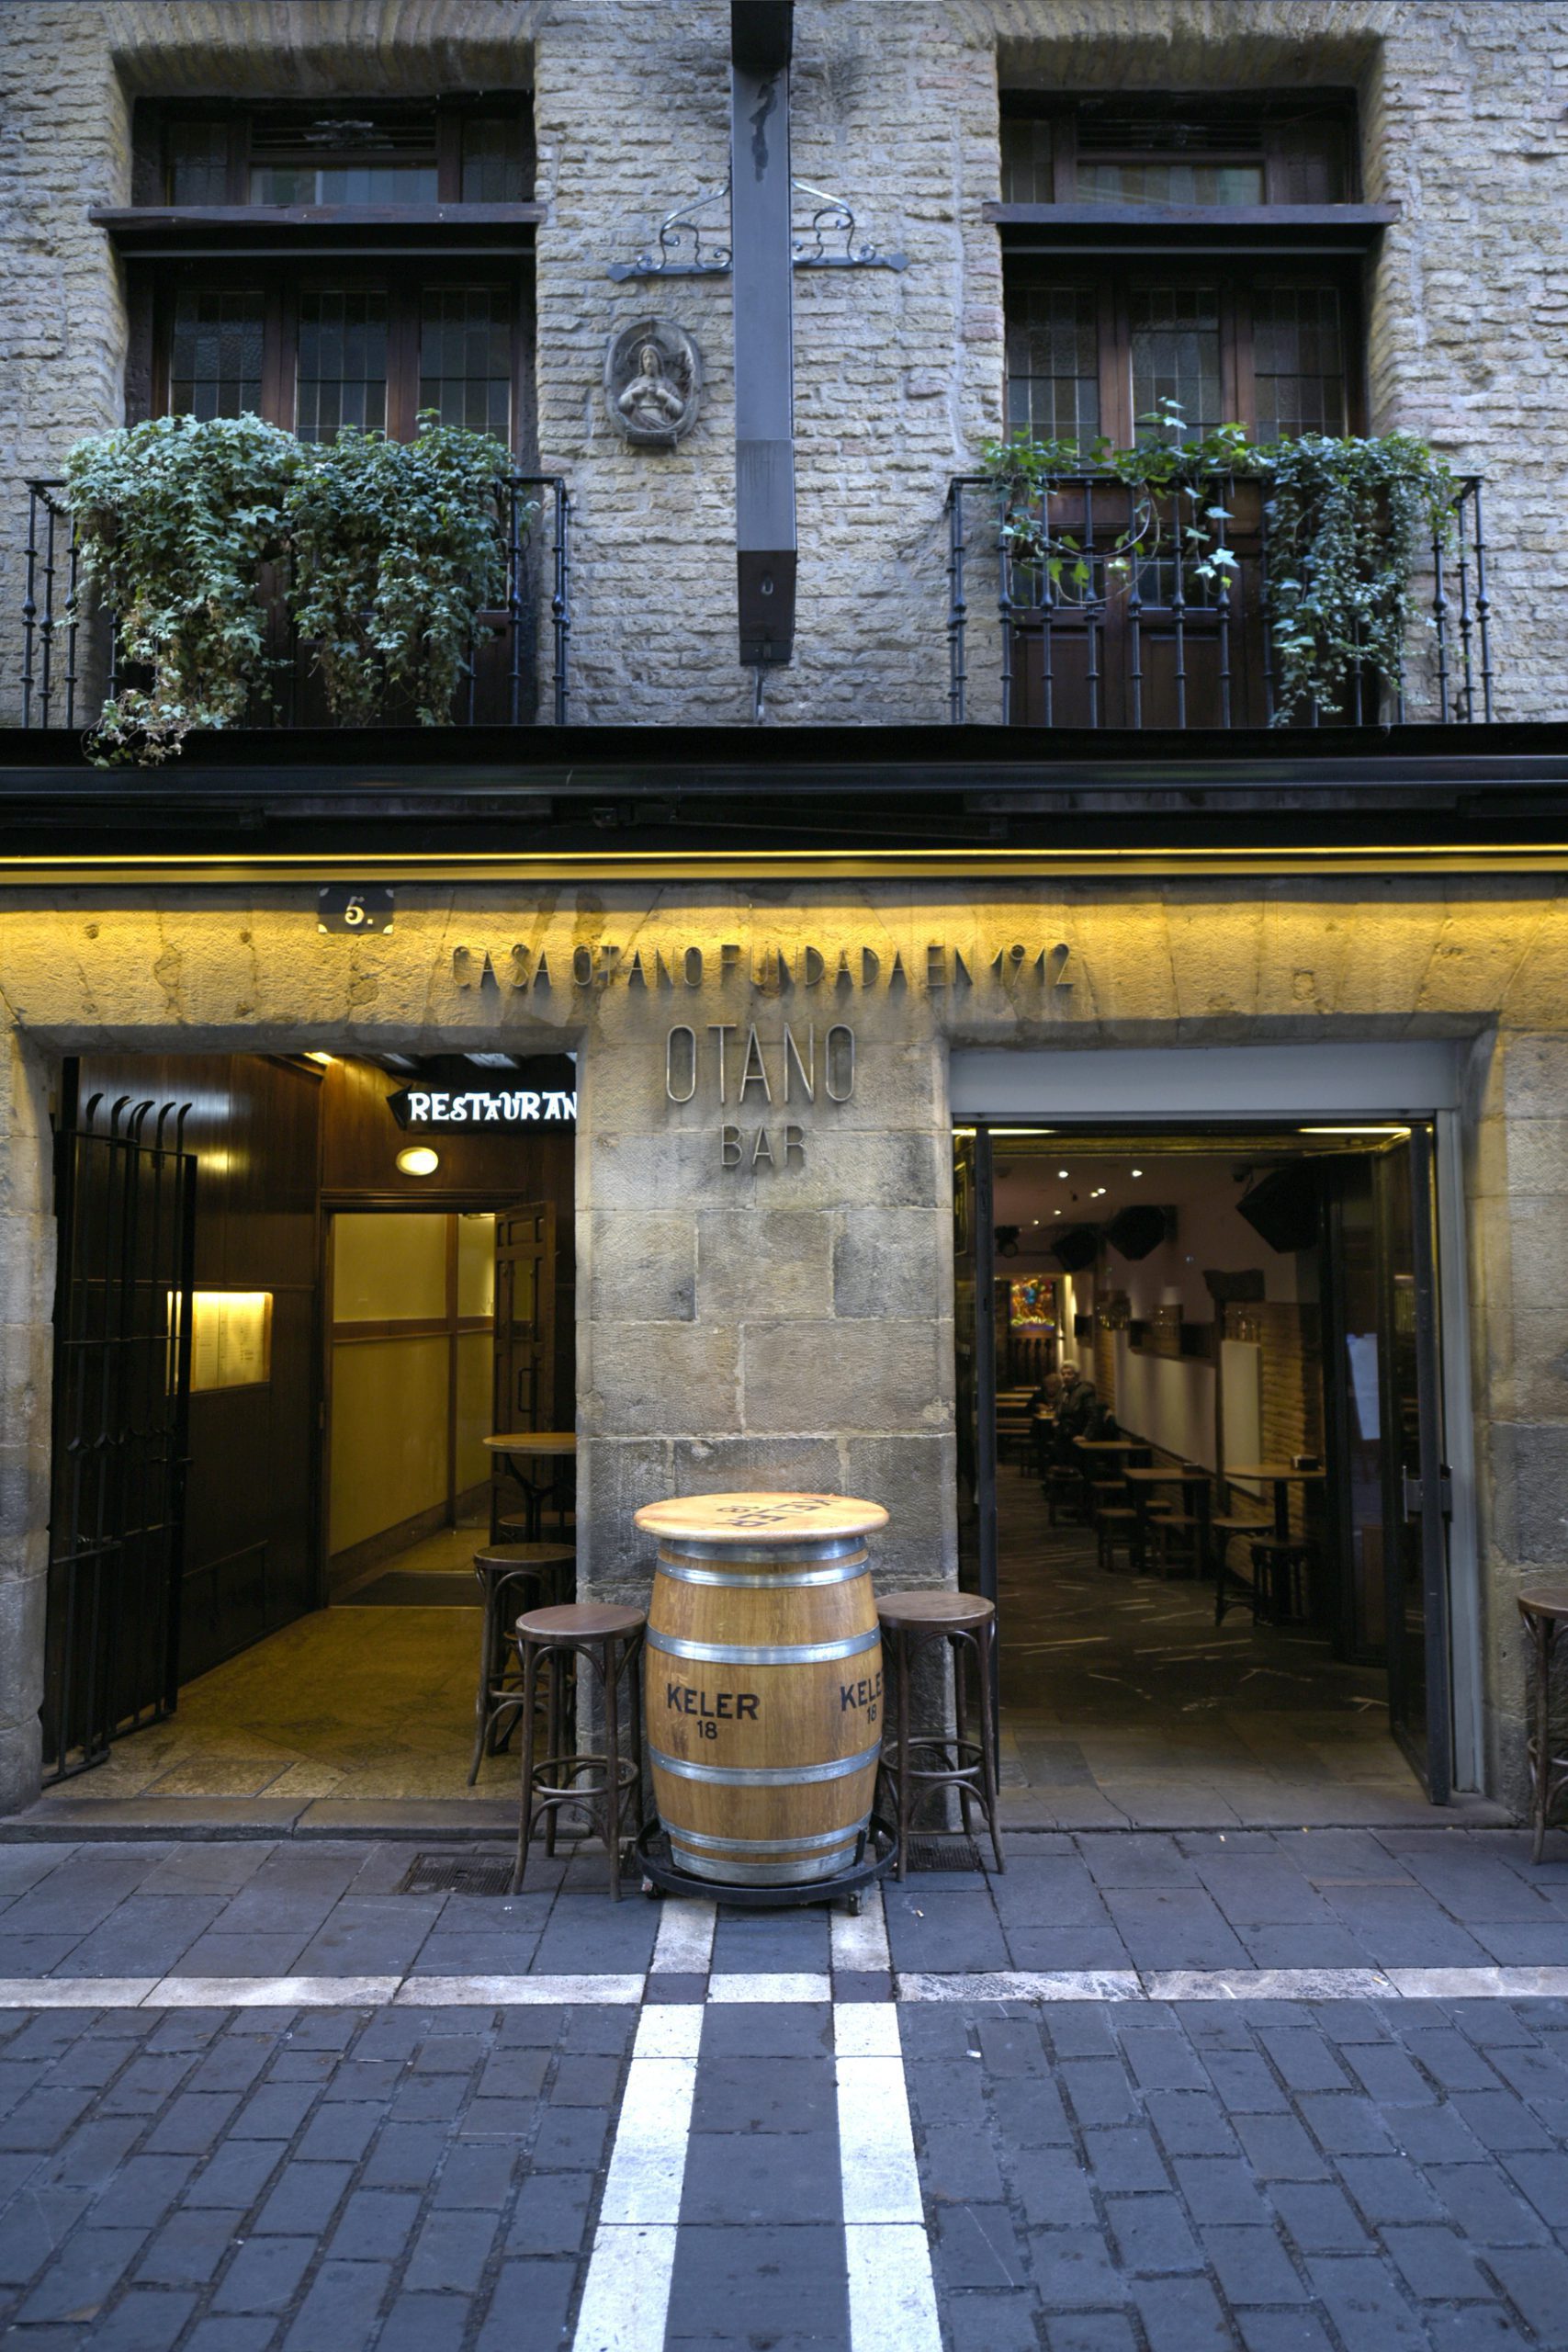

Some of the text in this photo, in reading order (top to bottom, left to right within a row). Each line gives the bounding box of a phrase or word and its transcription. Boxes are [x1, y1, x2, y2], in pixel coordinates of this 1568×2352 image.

[453, 943, 1075, 989] CASA OTANO FUNDADA EN 1912
[666, 1023, 856, 1102] OTANO
[721, 1124, 807, 1166] BAR
[714, 1498, 841, 1528] KELER
[667, 1682, 761, 1721] KELER
[840, 1670, 884, 1712] KELE
[696, 1720, 718, 1740] 18
[866, 1703, 877, 1724] 18
